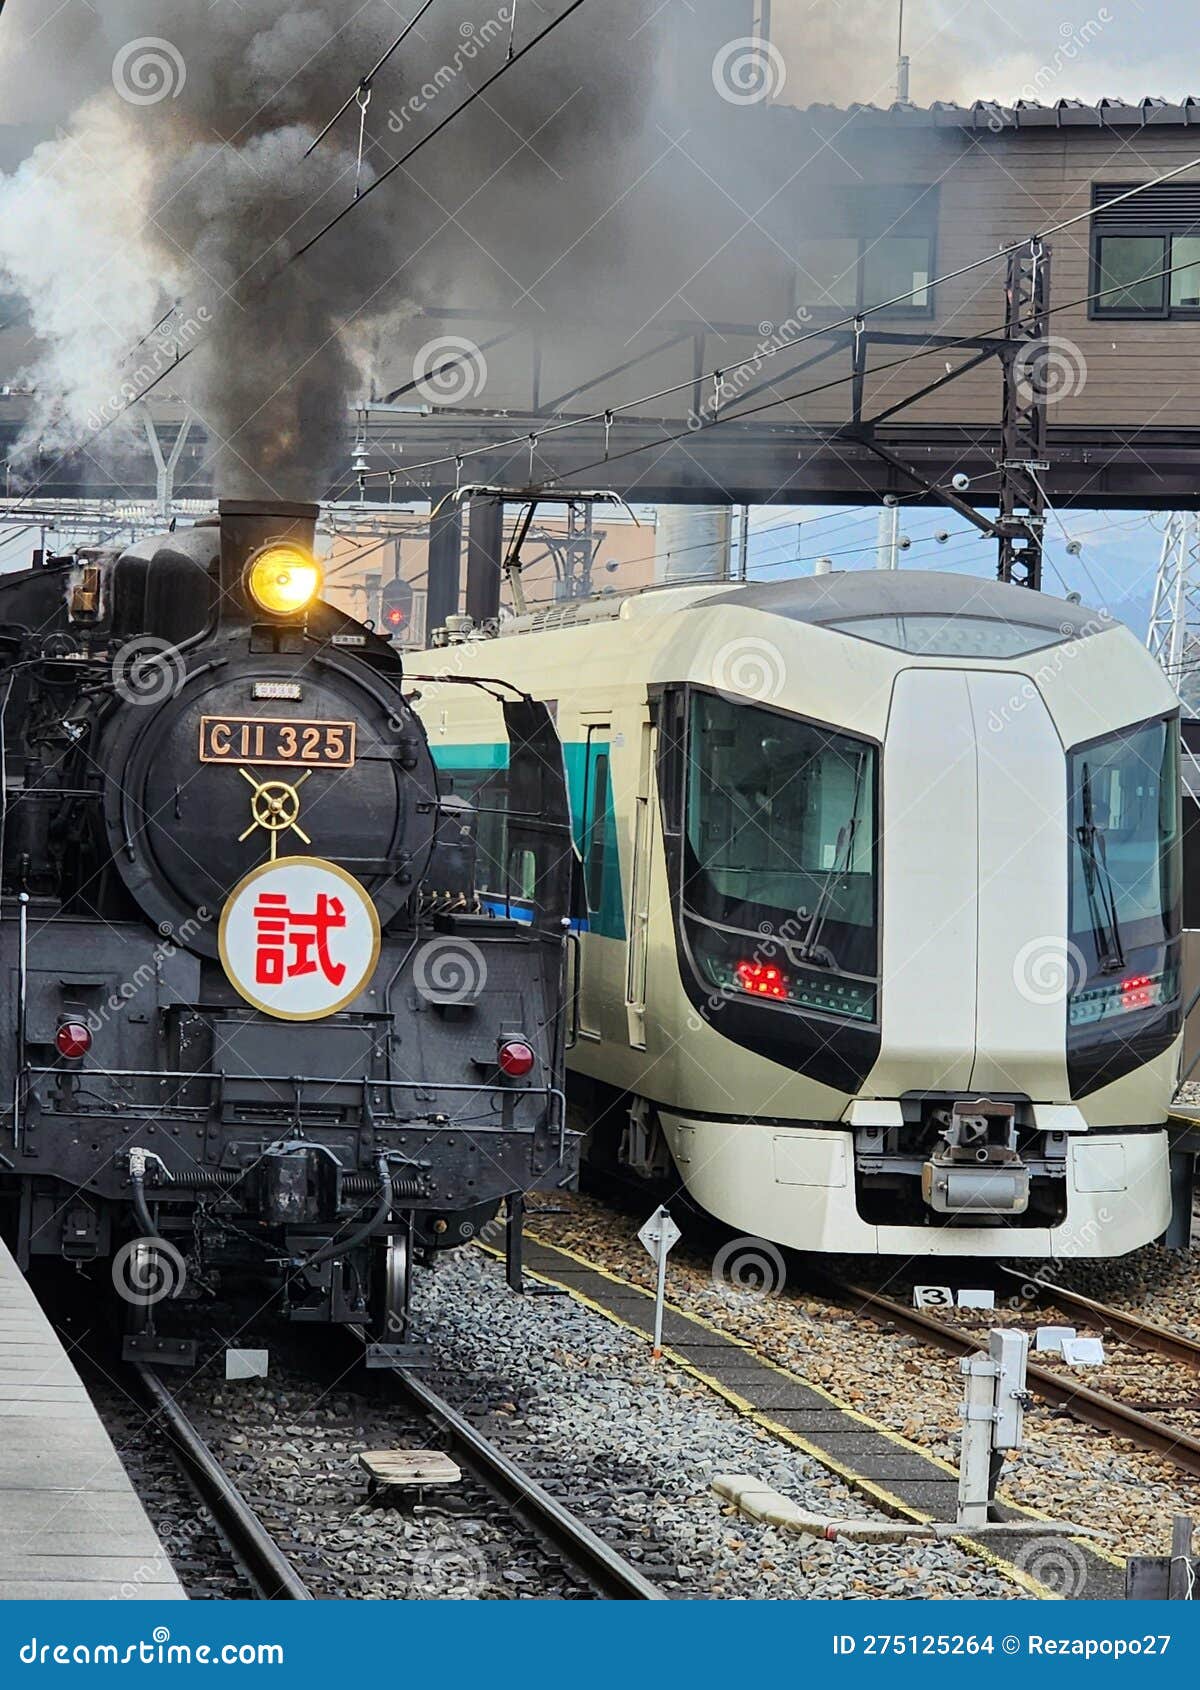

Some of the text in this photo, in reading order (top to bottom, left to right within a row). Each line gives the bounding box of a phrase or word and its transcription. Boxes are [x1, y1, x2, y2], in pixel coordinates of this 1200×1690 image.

[277, 727, 345, 759] 325
[253, 893, 346, 986] 試
[921, 1288, 948, 1305] 3
